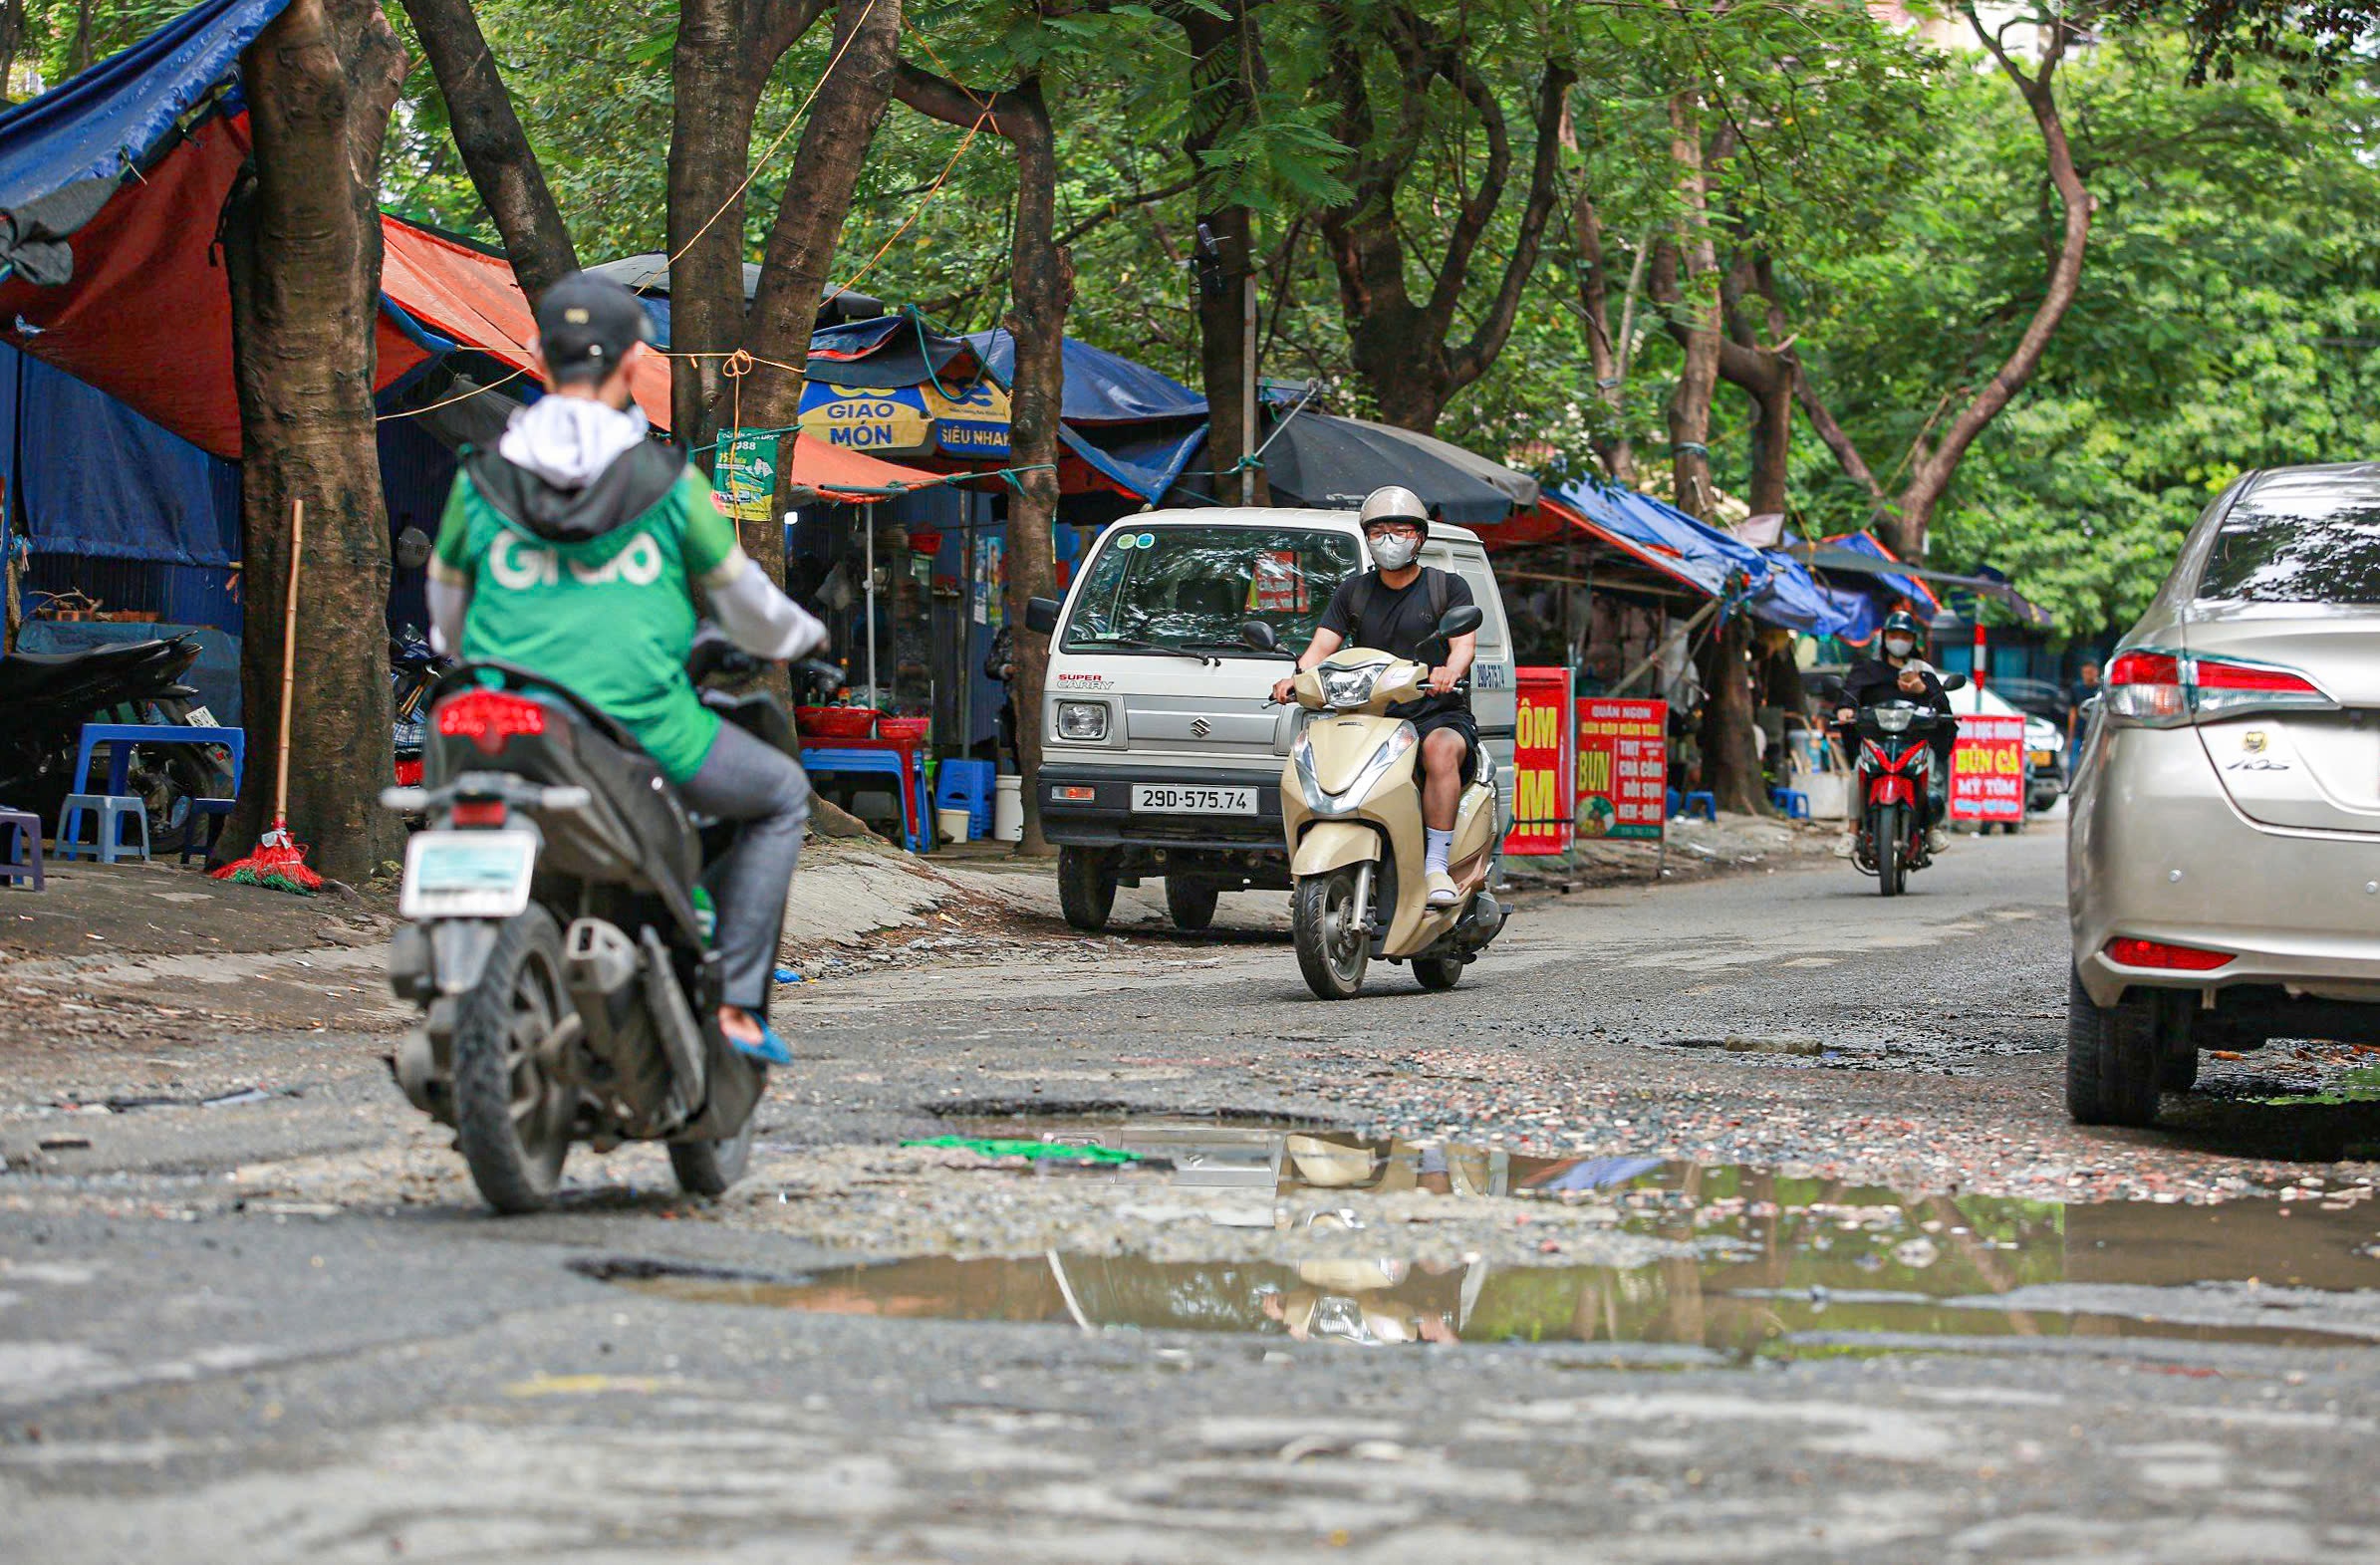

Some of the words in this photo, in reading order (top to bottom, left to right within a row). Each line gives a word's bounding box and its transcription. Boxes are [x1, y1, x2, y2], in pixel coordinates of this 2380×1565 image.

[827, 402, 895, 419] GIAO
[830, 419, 893, 446] MÓN
[941, 423, 970, 444] SIÊU
[1057, 680, 1115, 690] CARRY
[1577, 742, 1611, 792] BÚN
[1143, 790, 1247, 810] 29D-575.74
